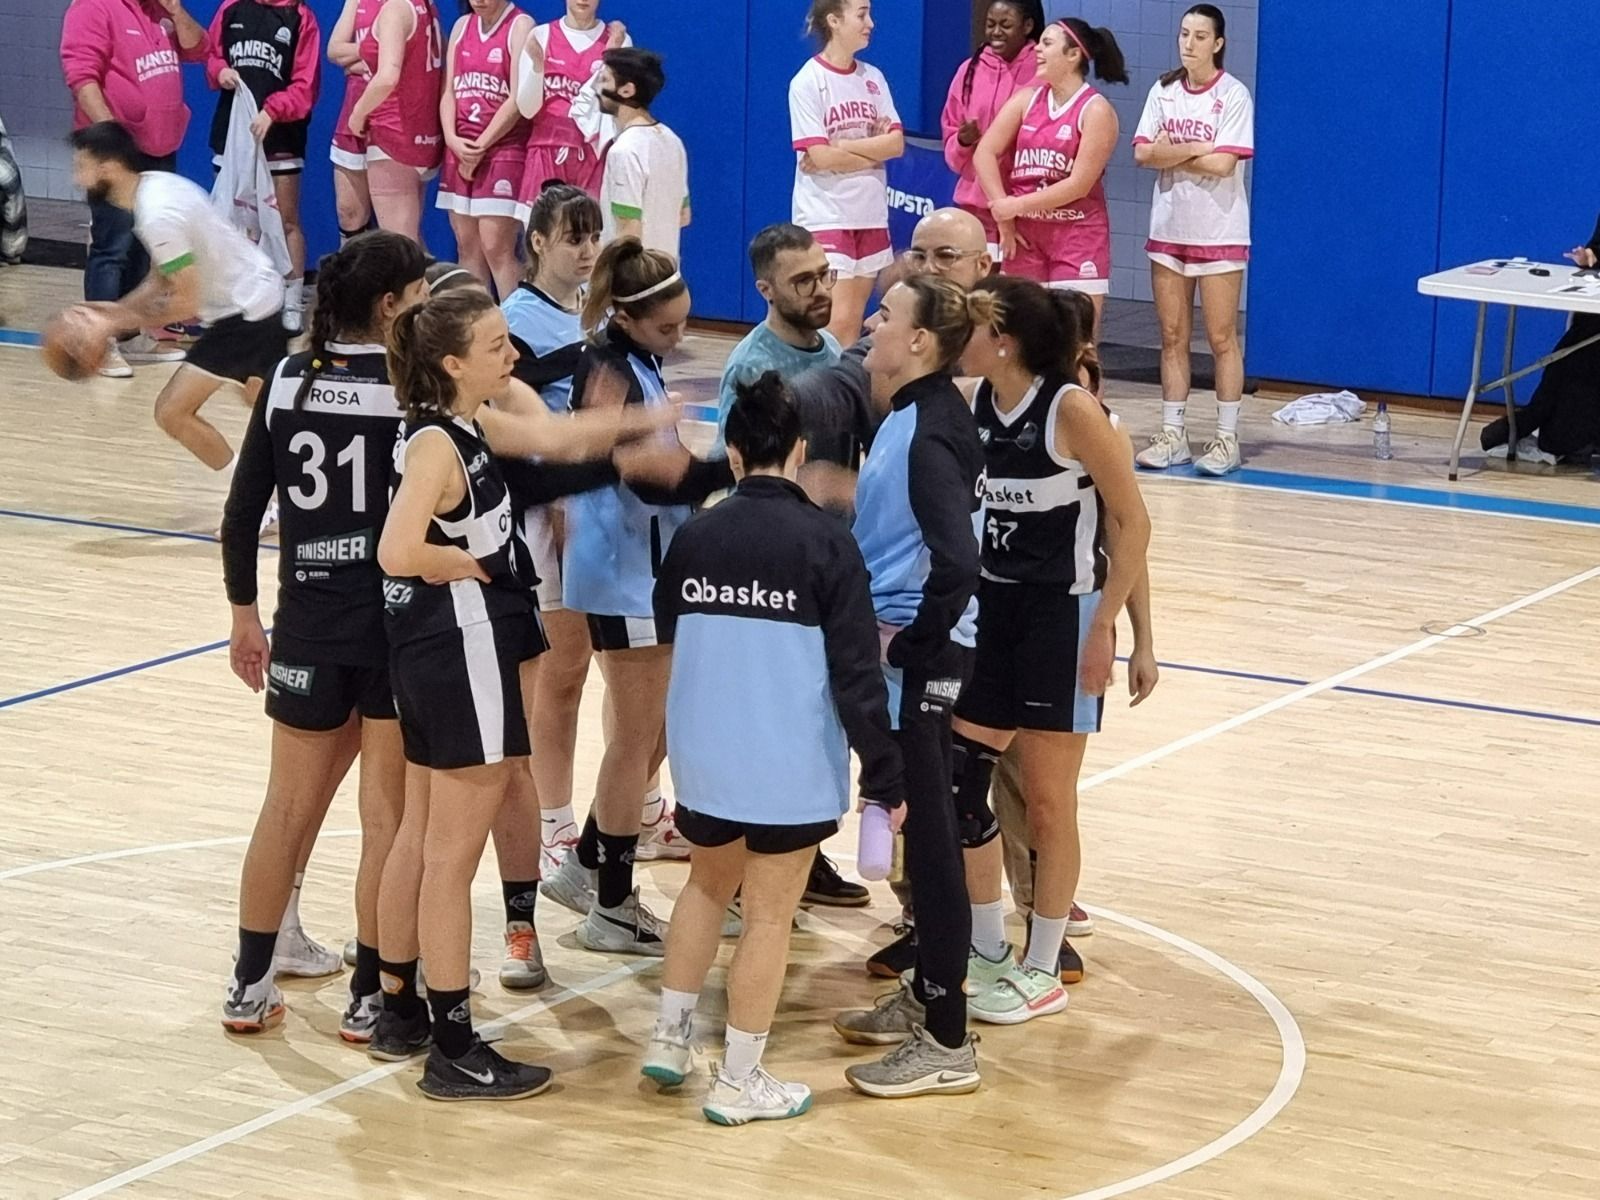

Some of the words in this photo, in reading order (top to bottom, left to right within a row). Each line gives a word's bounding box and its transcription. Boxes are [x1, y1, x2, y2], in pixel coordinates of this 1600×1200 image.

[468, 102, 481, 122] 2
[310, 387, 361, 406] ROSA
[287, 430, 367, 512] 31
[985, 485, 1035, 505] asket
[296, 536, 367, 560] FINISHER
[681, 577, 798, 612] Qbasket
